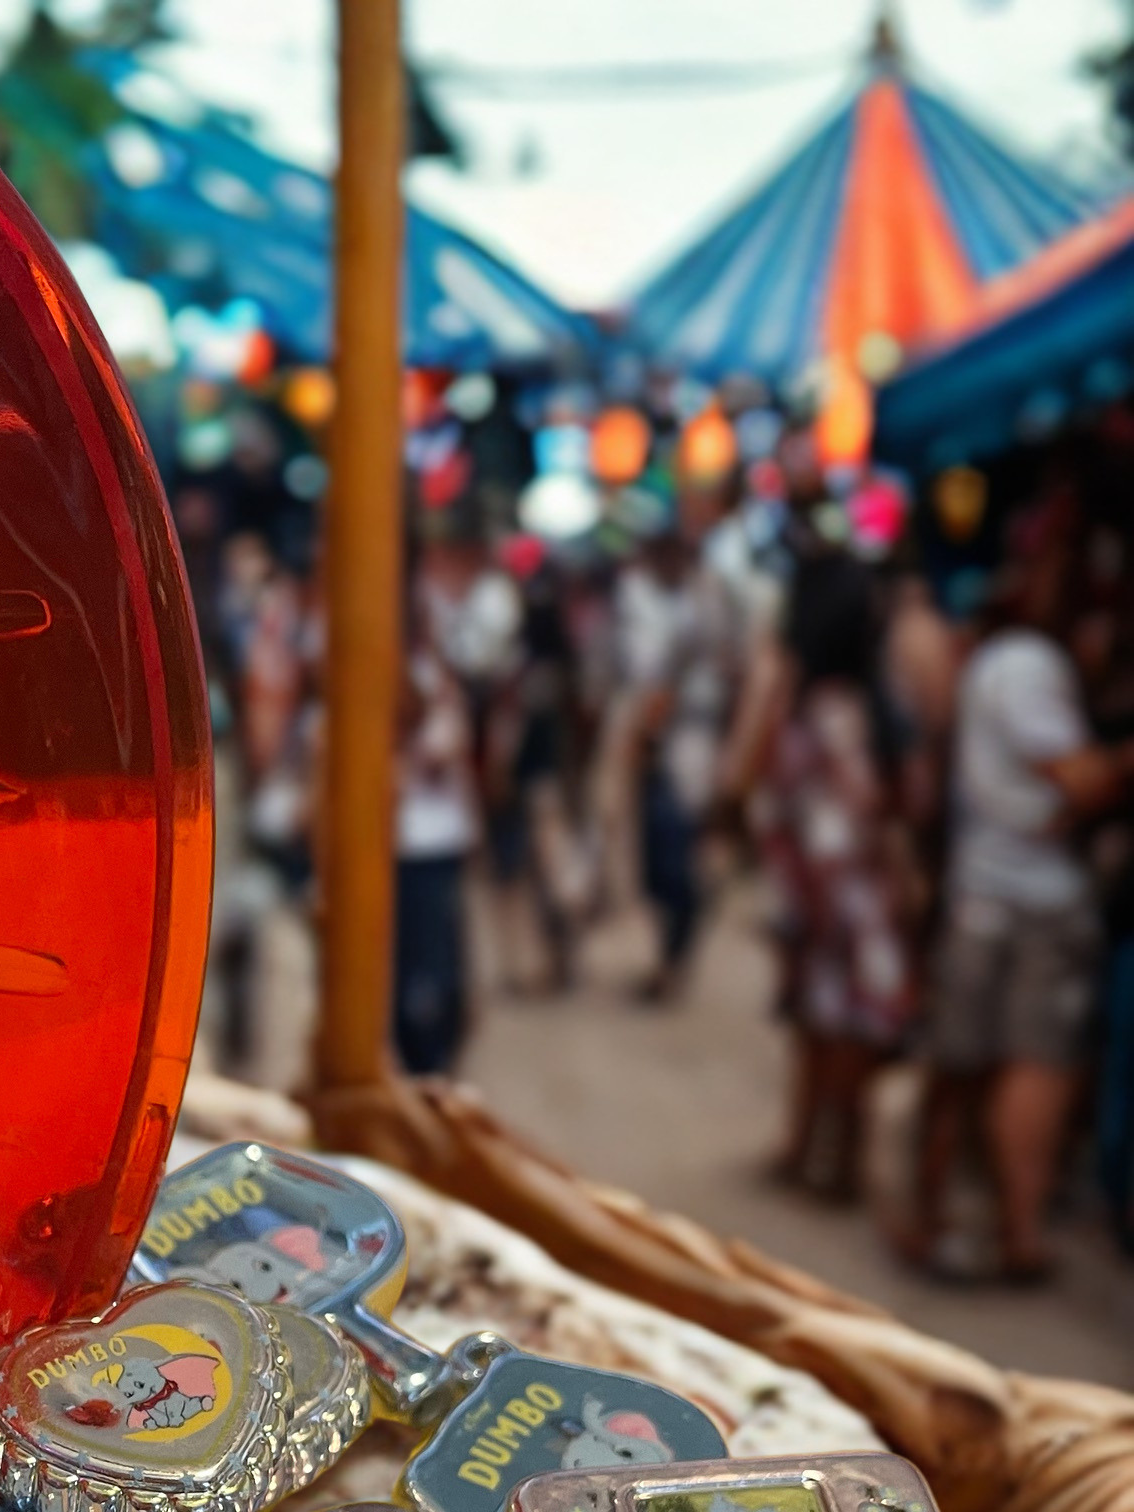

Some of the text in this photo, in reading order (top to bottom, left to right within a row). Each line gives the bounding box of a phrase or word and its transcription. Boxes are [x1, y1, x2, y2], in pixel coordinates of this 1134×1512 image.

[142, 1178, 263, 1258] DUMBO
[27, 1336, 127, 1390] DUMBO
[458, 1383, 563, 1491] DUMBO
